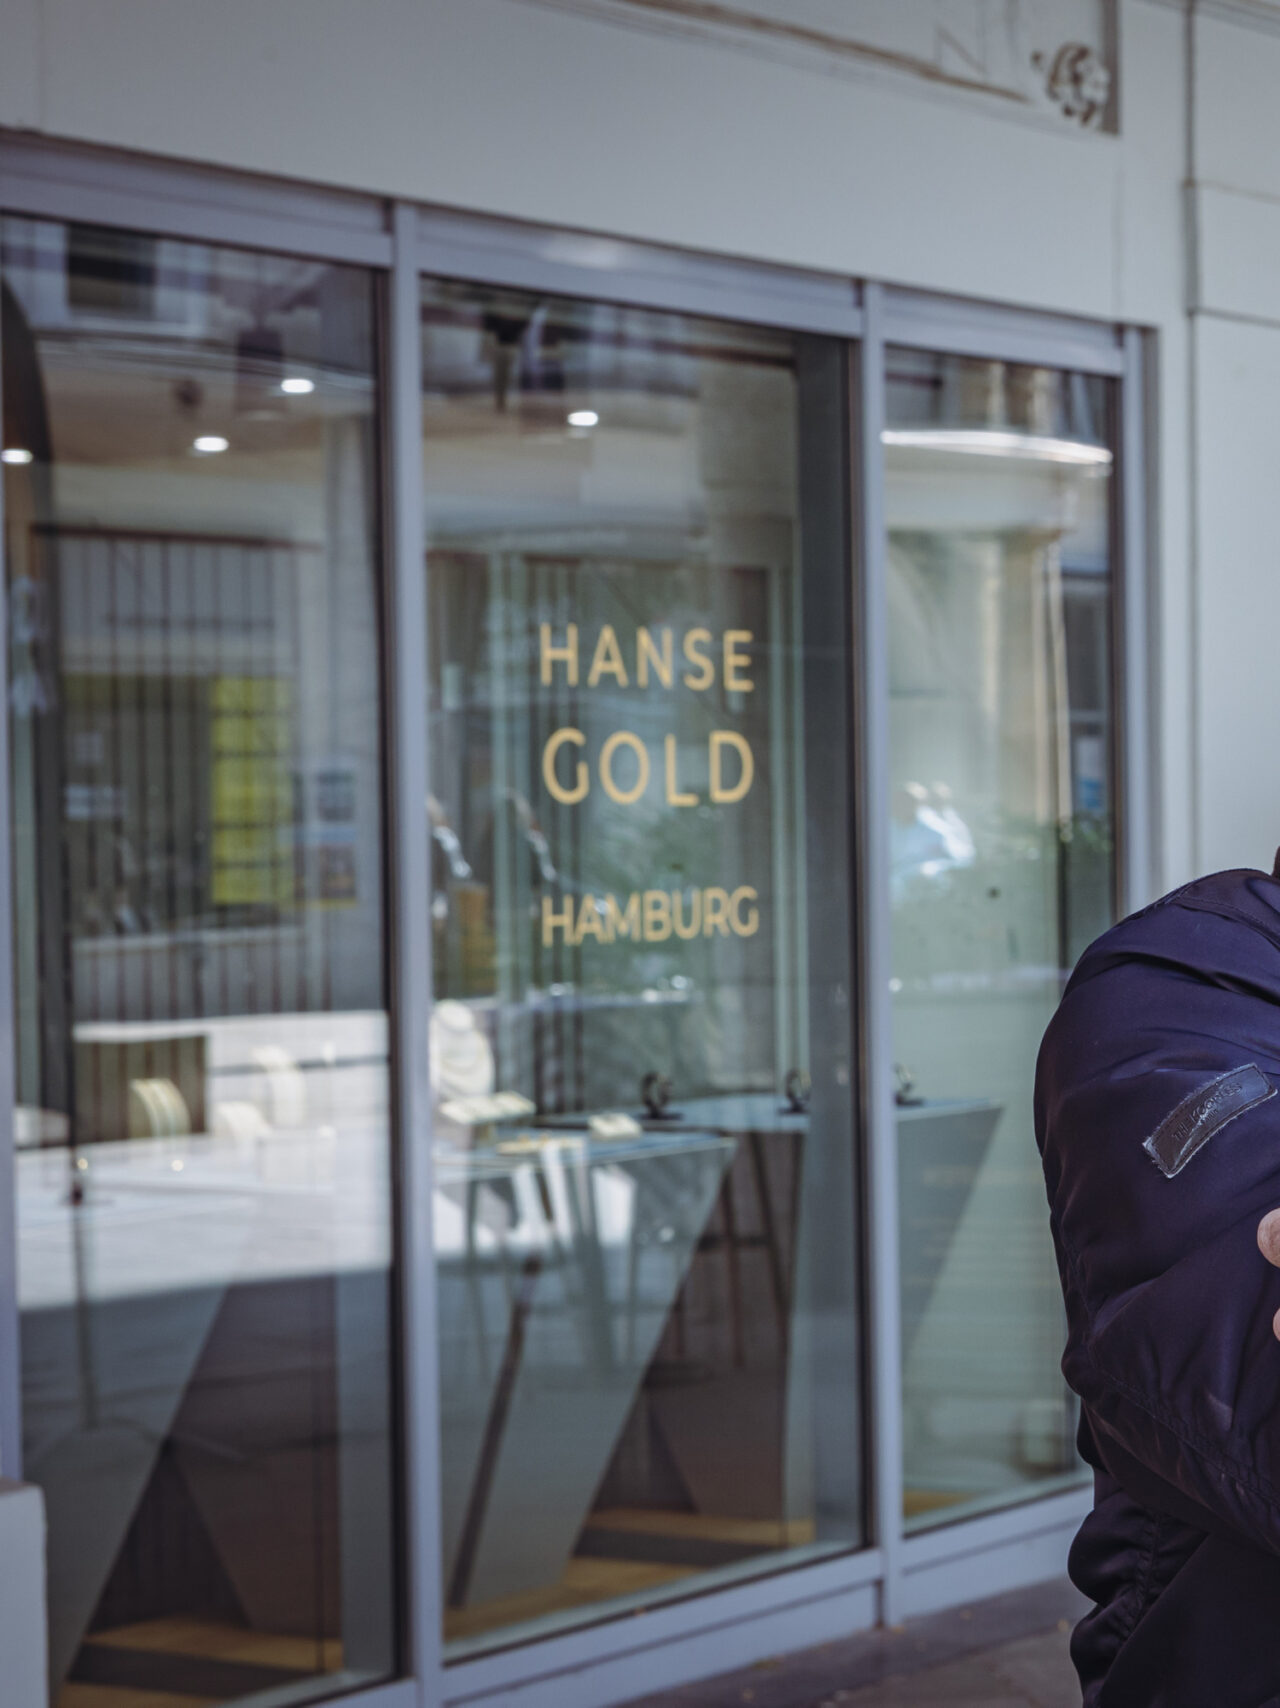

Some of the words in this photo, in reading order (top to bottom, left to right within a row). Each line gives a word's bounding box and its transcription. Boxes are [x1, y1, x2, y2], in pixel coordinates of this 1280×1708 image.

[540, 622, 754, 692] HANSE
[542, 727, 755, 806] GOLD
[541, 886, 760, 948] HAMBURG
